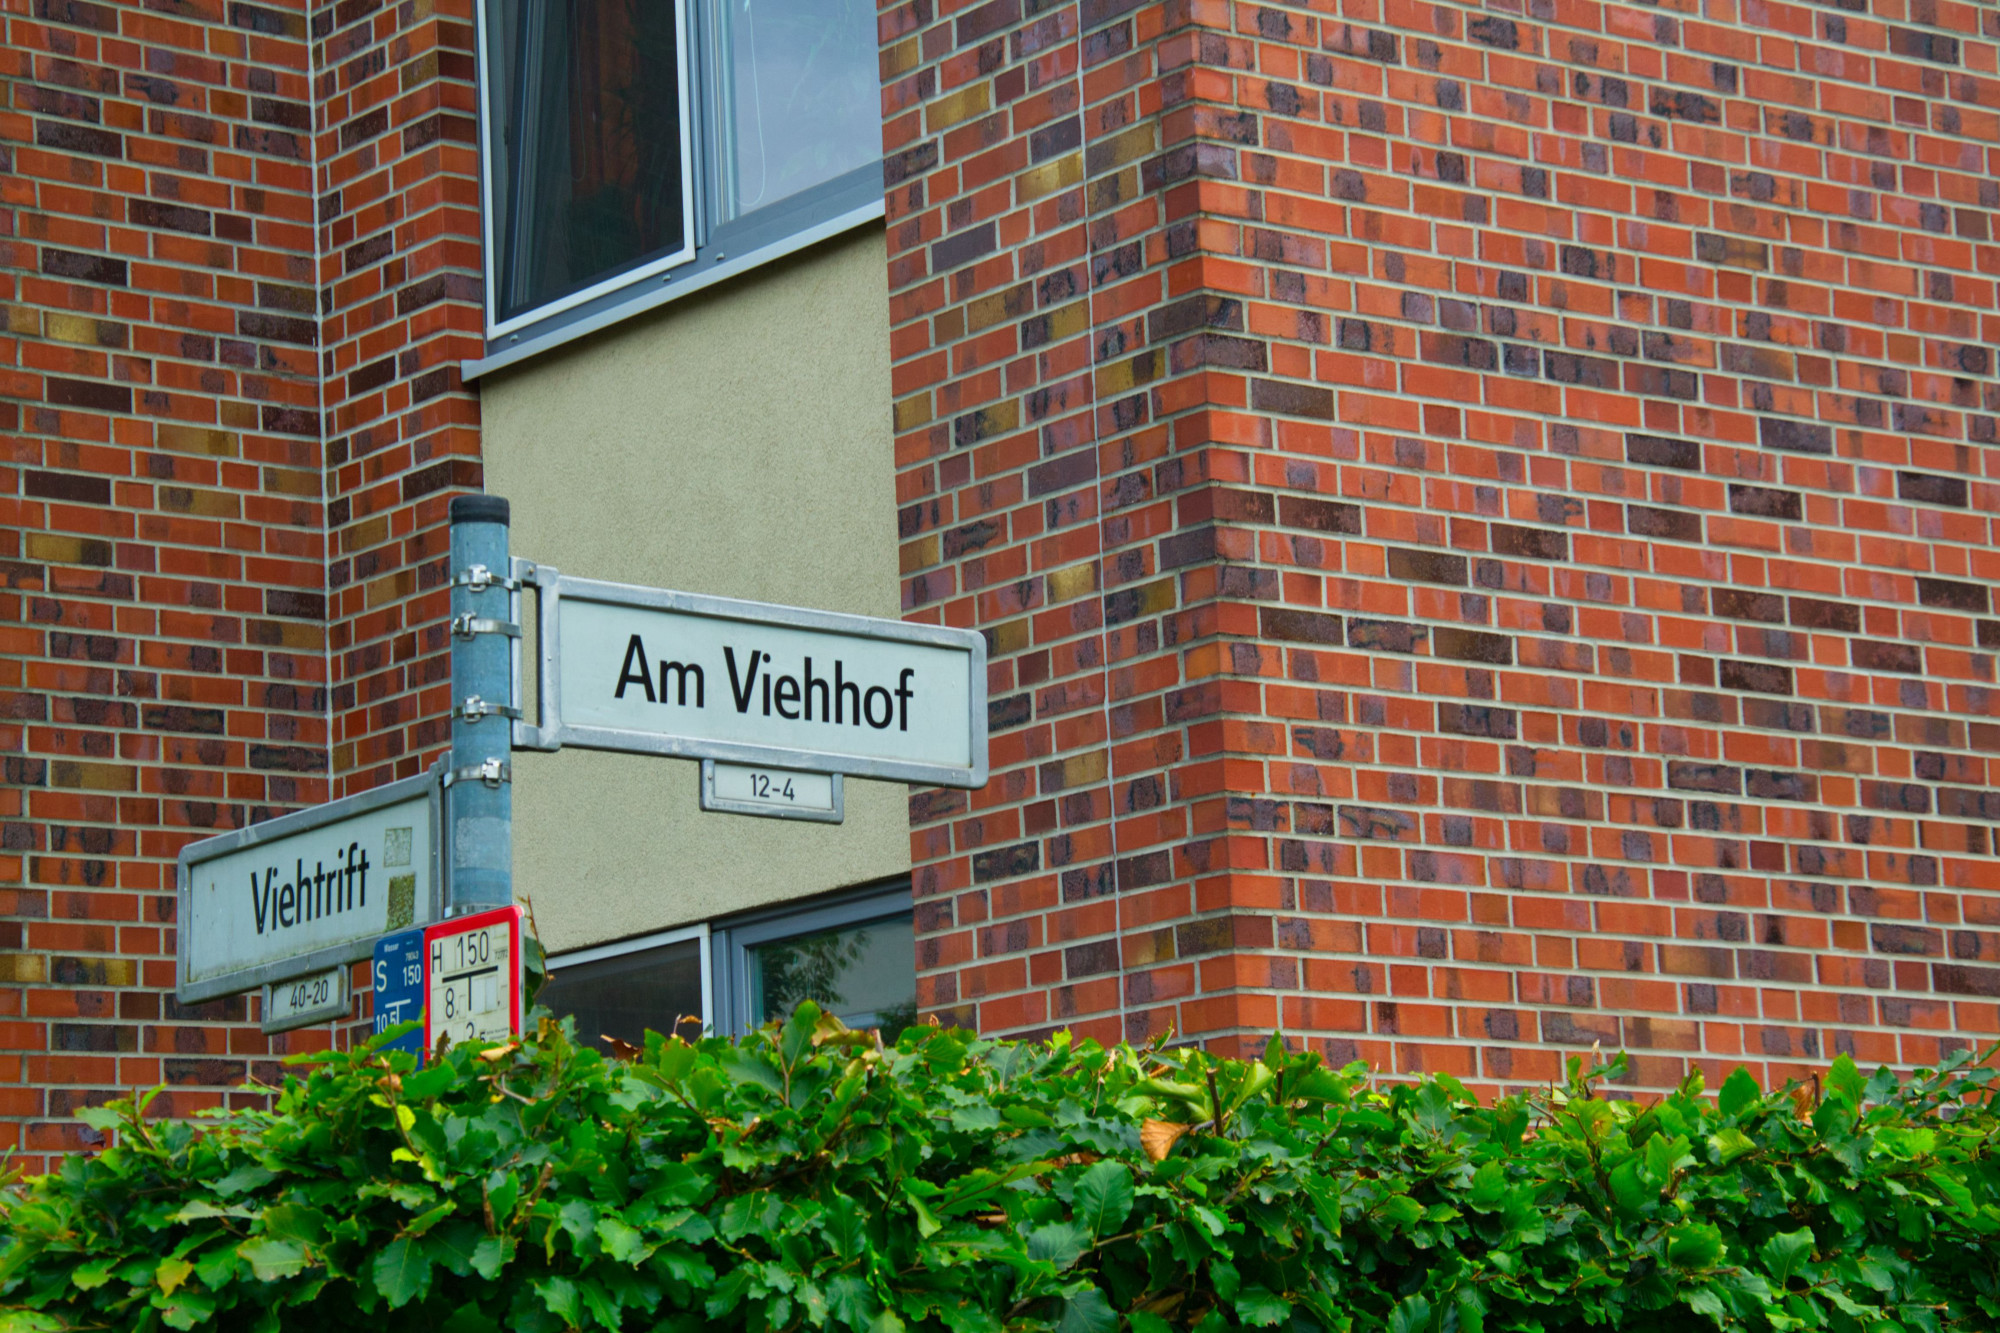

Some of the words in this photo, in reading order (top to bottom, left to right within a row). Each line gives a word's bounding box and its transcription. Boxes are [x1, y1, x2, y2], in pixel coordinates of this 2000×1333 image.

[614, 634, 705, 709] Am
[723, 646, 915, 732] Viehhof
[750, 773, 795, 801] 12-4
[250, 842, 370, 935] Viehtrift
[431, 941, 442, 974] H
[457, 931, 489, 968] 150
[289, 979, 329, 1010] 40-20
[376, 960, 387, 993] S
[403, 964, 422, 987] 150
